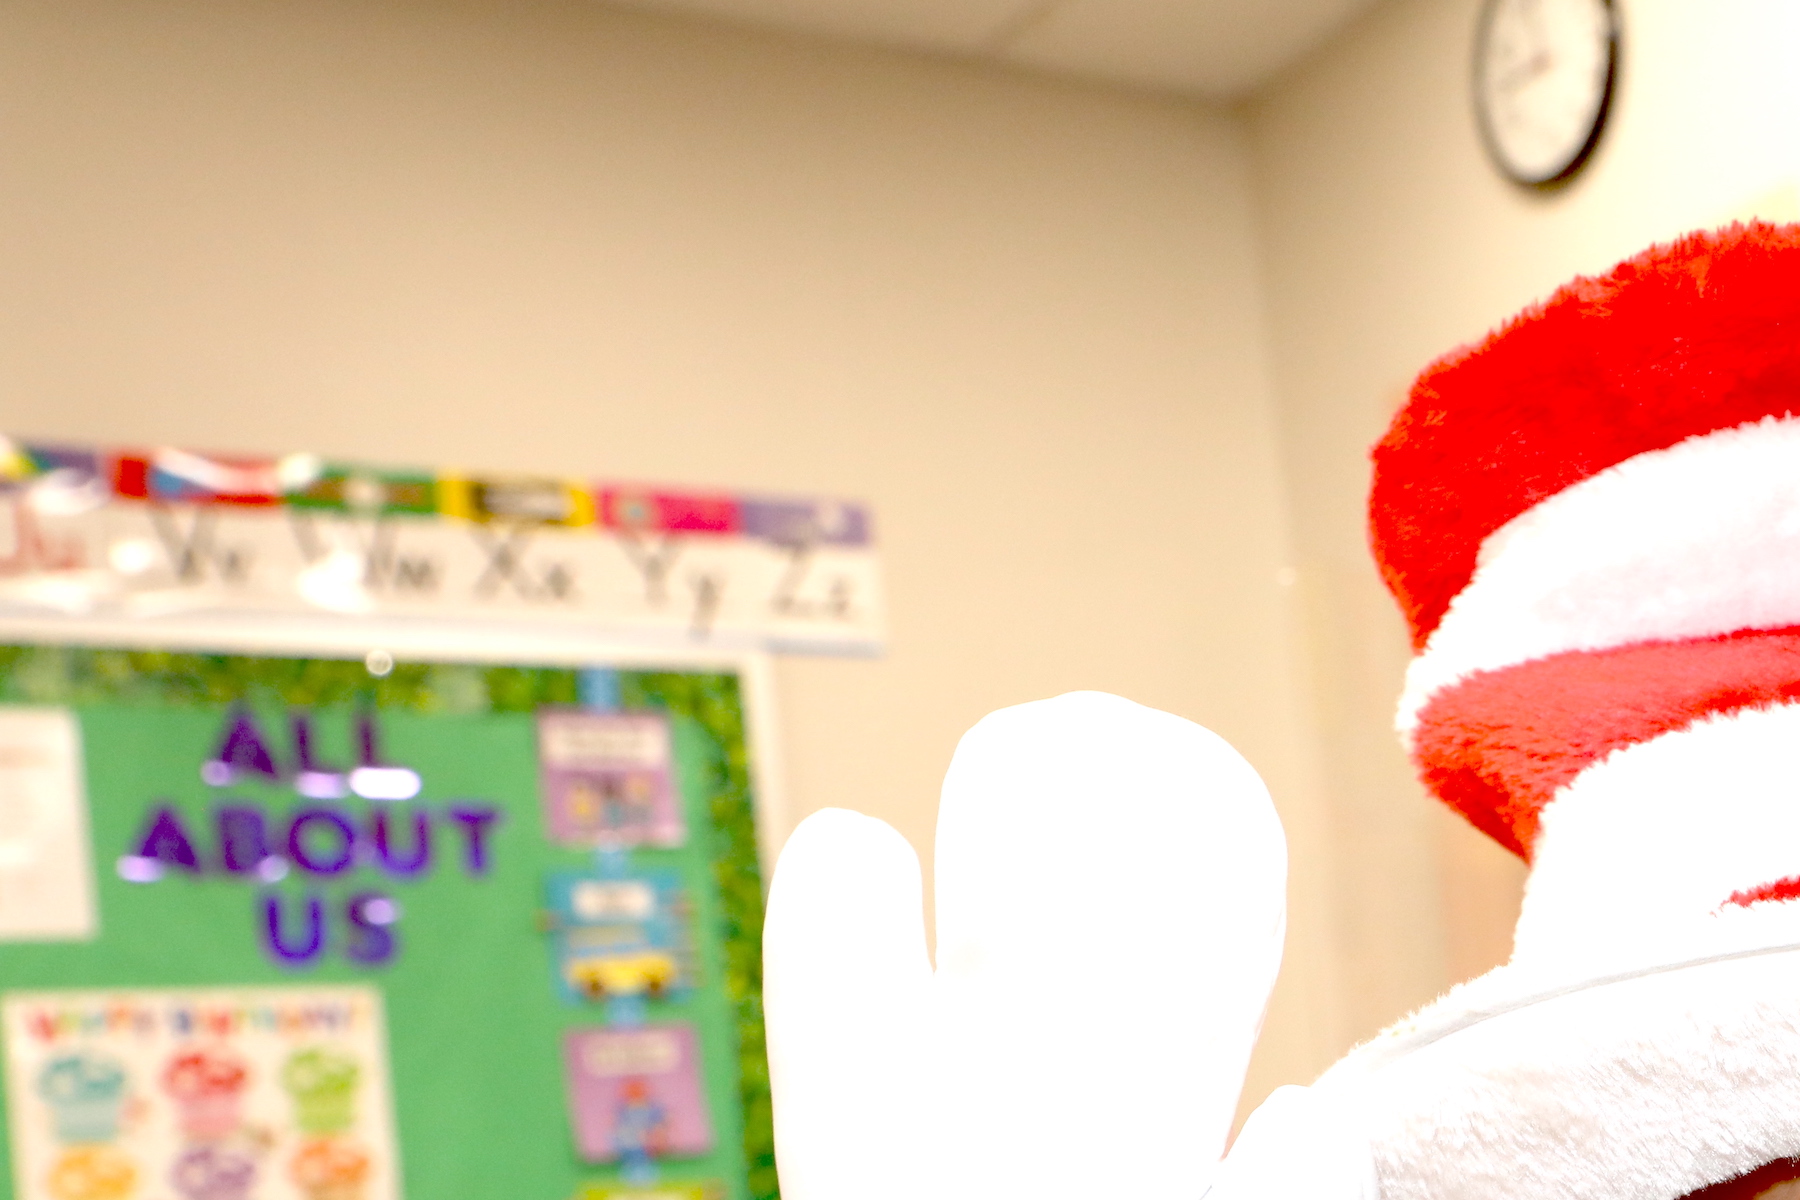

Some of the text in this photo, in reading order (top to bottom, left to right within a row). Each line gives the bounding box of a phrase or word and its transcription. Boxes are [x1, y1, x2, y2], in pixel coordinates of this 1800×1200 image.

[612, 530, 732, 642] Yy
[203, 704, 421, 800] ALL
[118, 802, 500, 880] ABOUT
[262, 893, 399, 968] US
